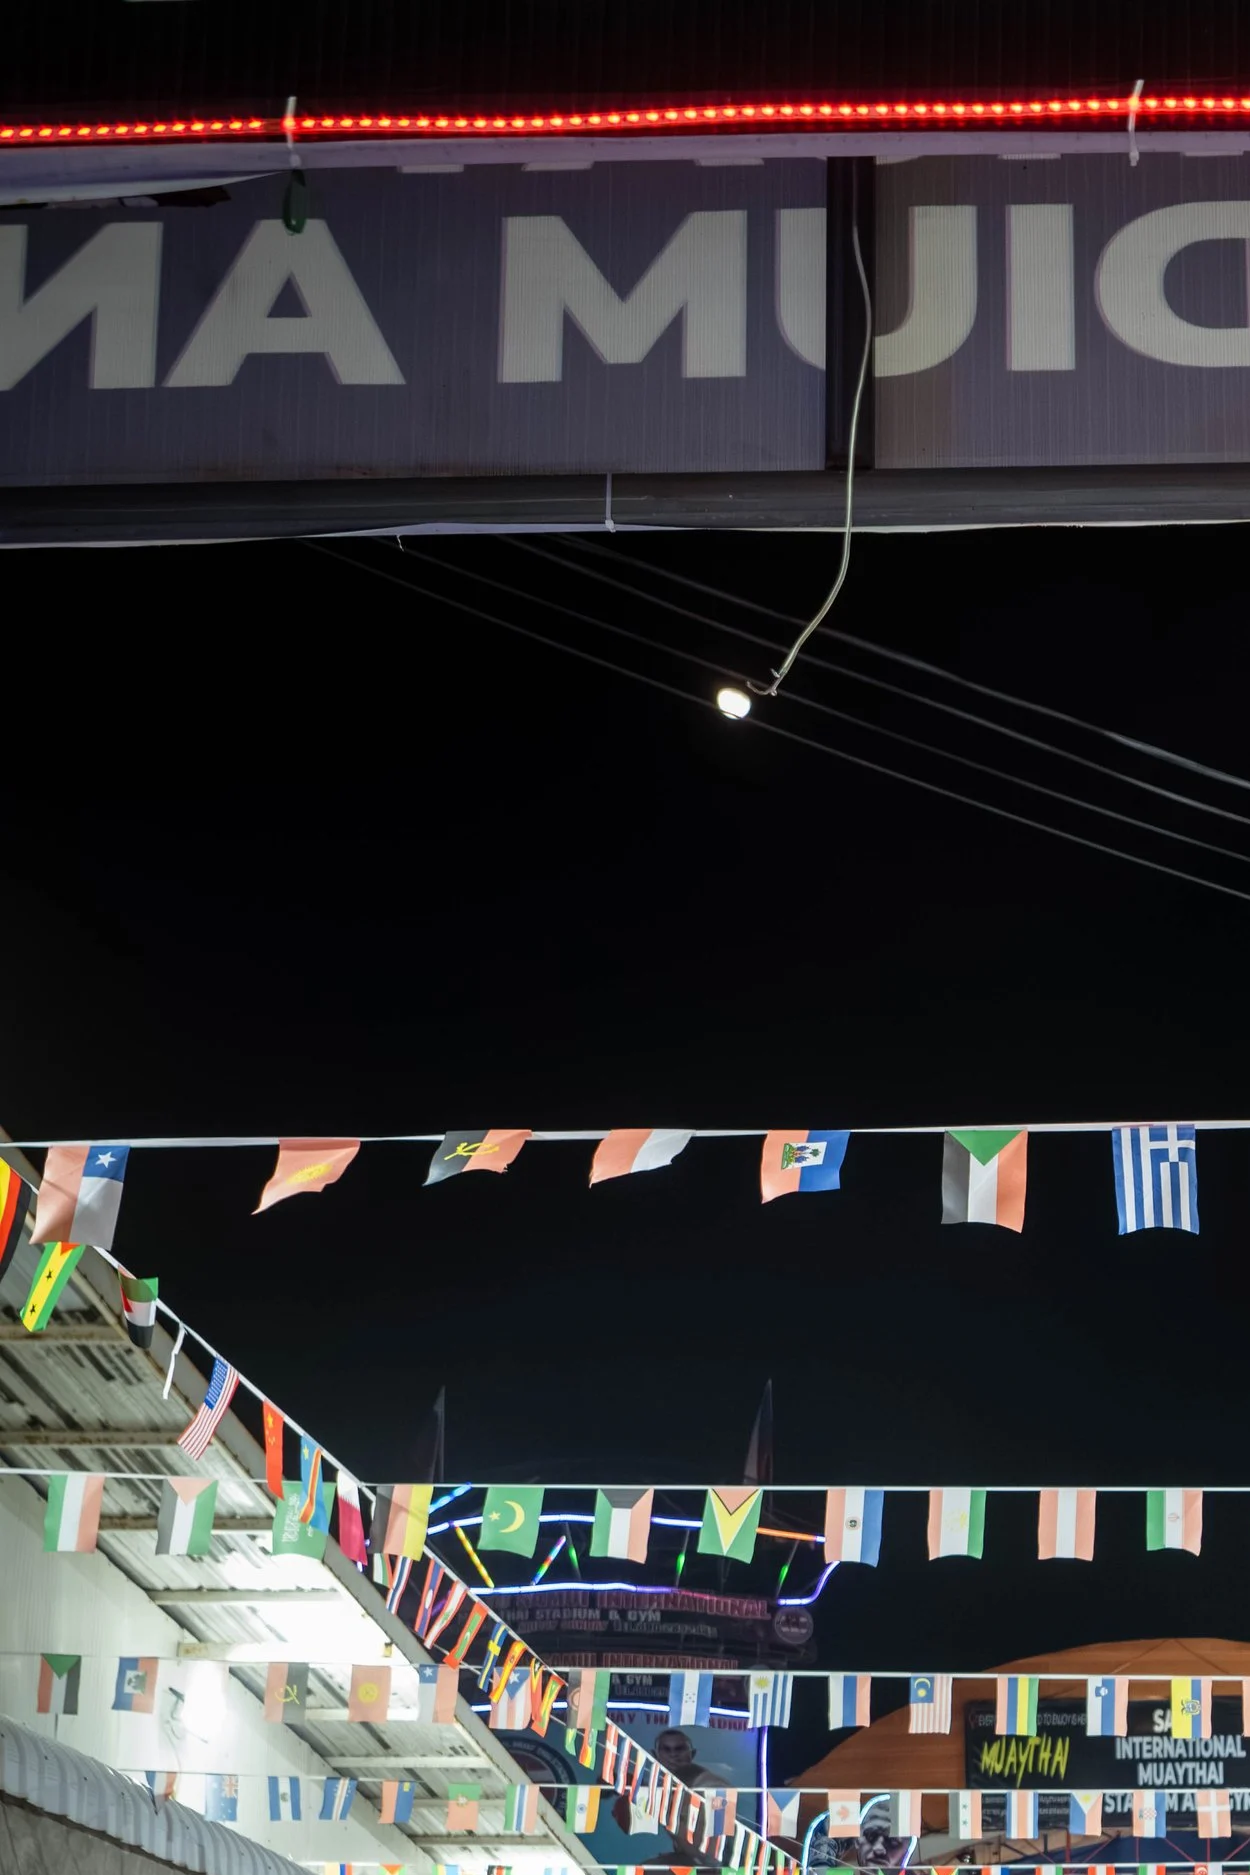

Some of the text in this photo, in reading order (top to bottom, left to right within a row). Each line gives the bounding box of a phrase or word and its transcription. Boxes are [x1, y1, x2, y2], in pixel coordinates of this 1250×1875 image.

[535, 1608, 601, 1620] STADIUM
[627, 1609, 661, 1622] GYM
[1115, 1736, 1247, 1760] INTERNATIONAL
[980, 1735, 1069, 1787] MUAYTHAI
[1137, 1762, 1224, 1786] MUAYTHAI
[1104, 1792, 1180, 1813] STAM
